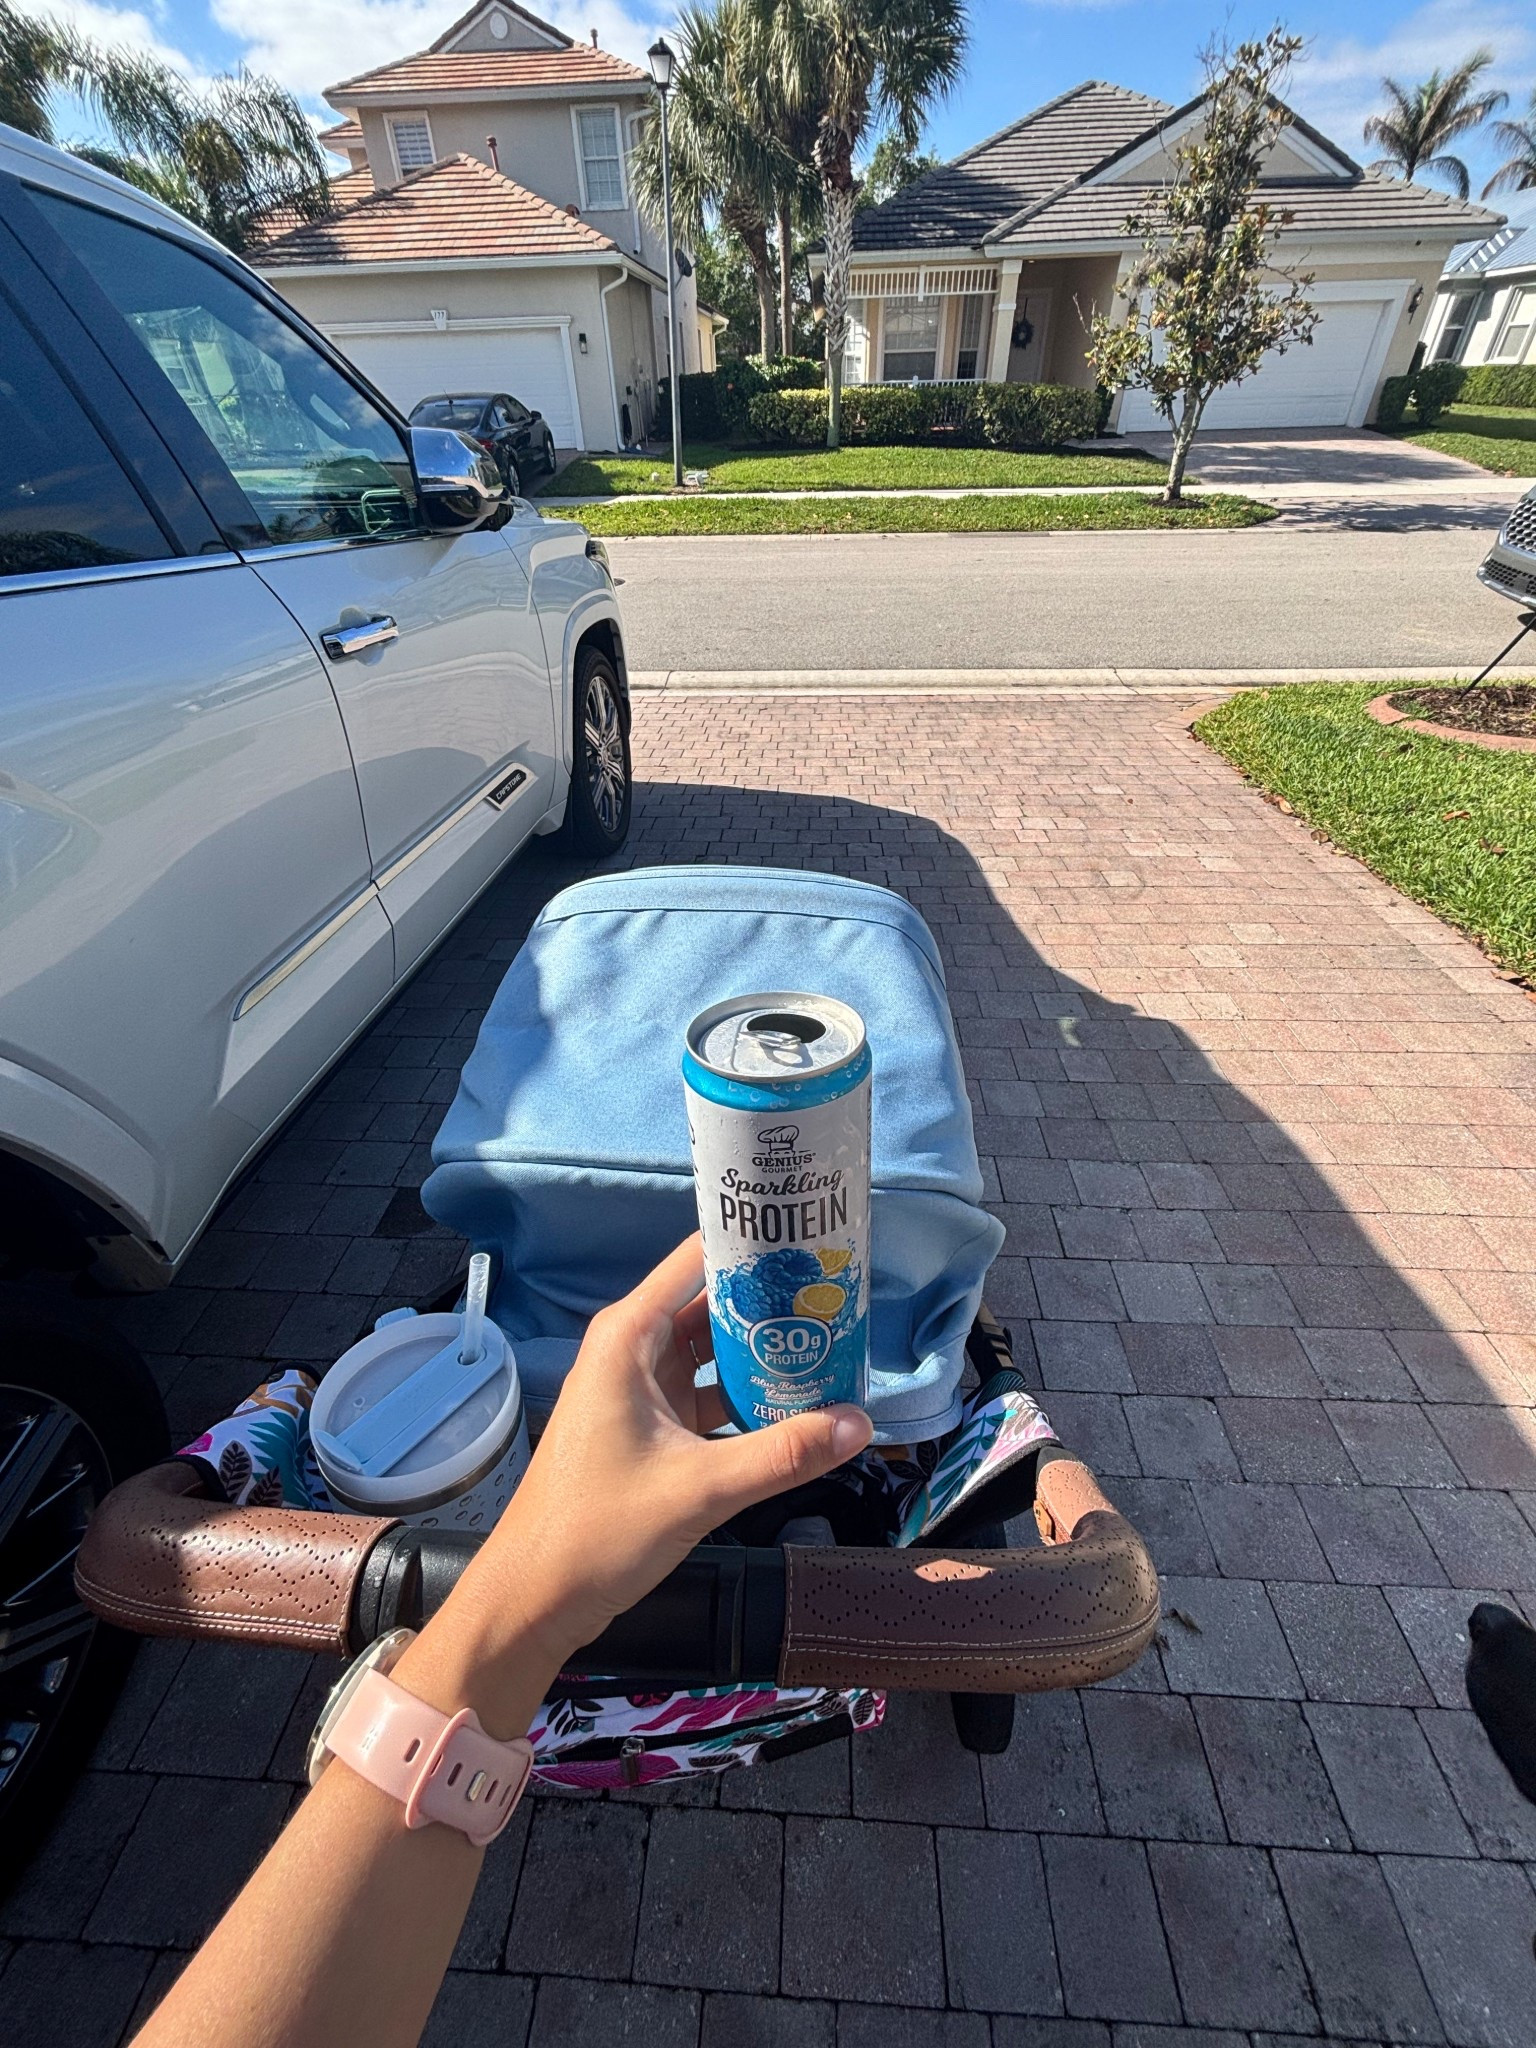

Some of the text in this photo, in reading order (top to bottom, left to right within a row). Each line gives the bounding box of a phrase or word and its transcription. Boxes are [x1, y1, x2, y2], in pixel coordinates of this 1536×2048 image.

[495, 773, 522, 800] CAPSTONE
[752, 1153, 813, 1167] GENIUS
[761, 1165, 803, 1173] GOURMET
[721, 1168, 844, 1197] Sparkling
[719, 1187, 847, 1243] PROTEIN
[762, 1328, 821, 1353] 30g
[765, 1350, 819, 1365] PROTEIN
[749, 1374, 835, 1391] Blue Raspberry
[764, 1387, 823, 1400] Lemonade
[765, 1395, 822, 1406] NATURAL FLAVORS
[752, 1402, 787, 1422] ZERO
